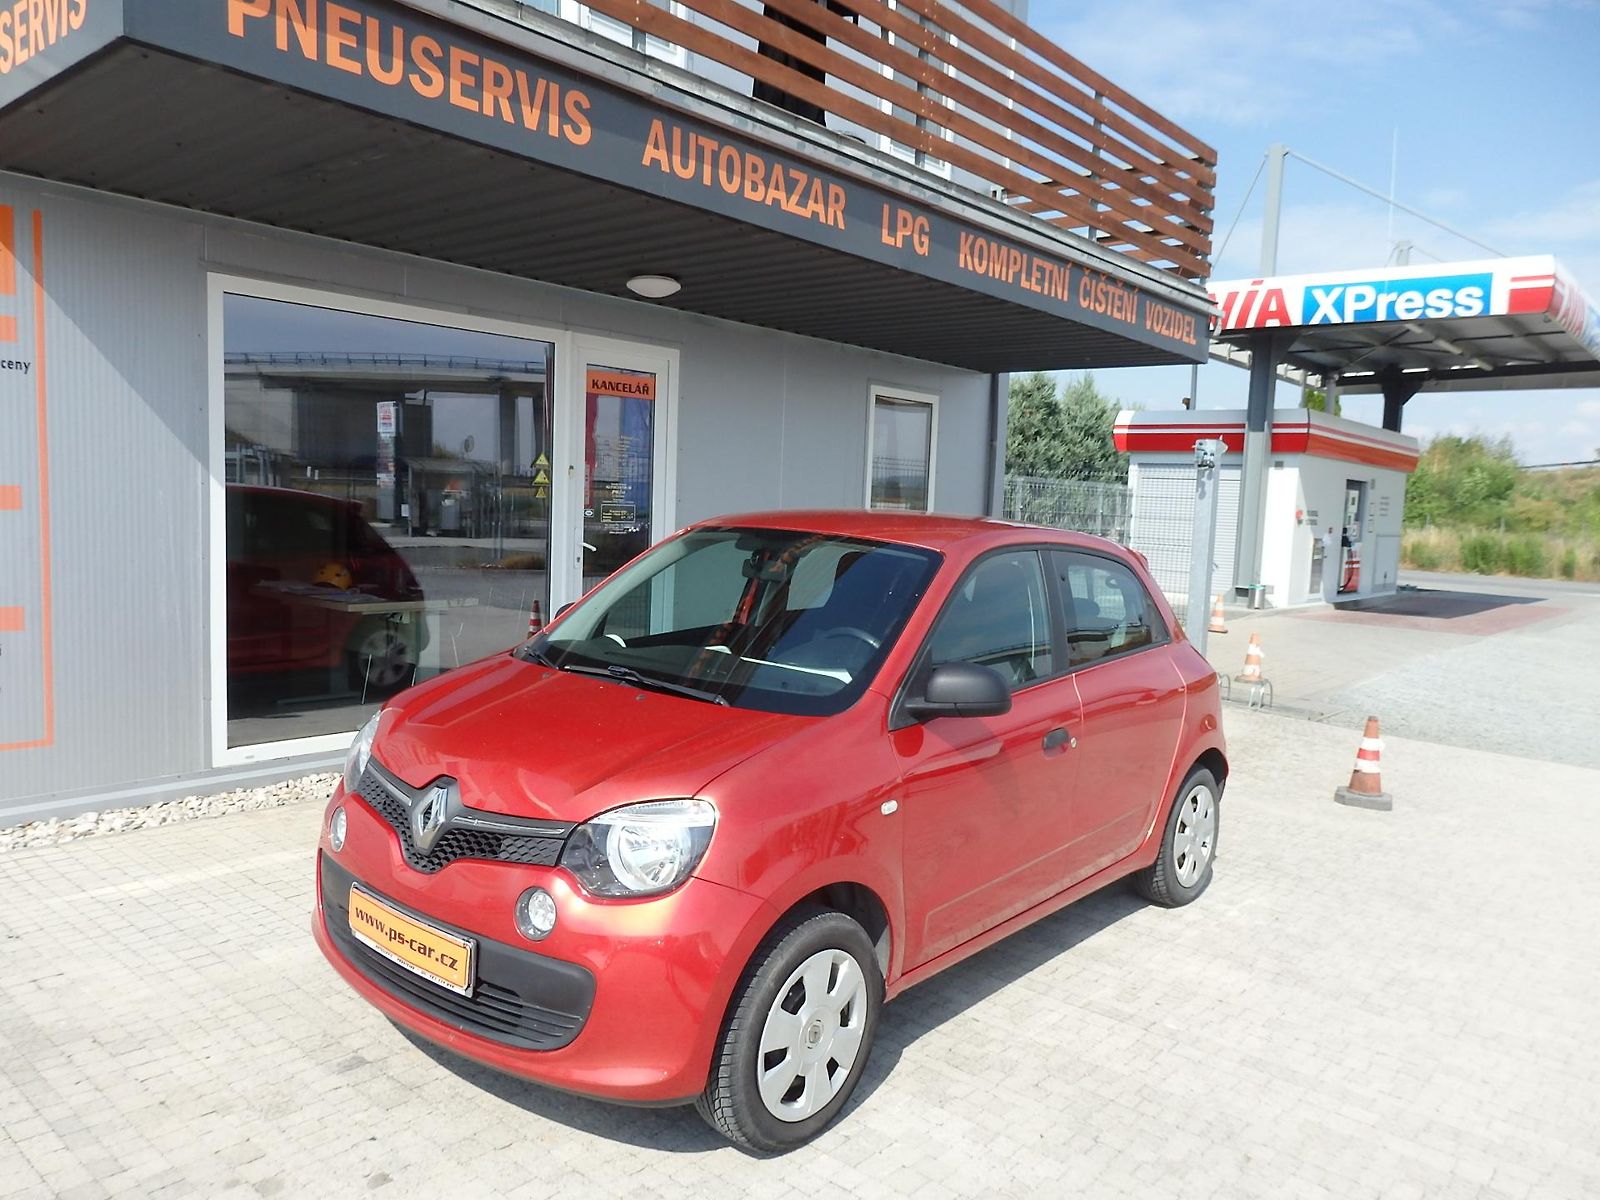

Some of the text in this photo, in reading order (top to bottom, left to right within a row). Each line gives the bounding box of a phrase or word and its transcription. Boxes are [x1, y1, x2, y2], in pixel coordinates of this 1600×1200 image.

[228, 0, 1197, 346] PNEUSERVIS AUTOBAZAR LPG KOMPLETNÍ ČIŠTĚNÍ VOZIDEL
[1309, 284, 1484, 326] XPress
[1, 359, 31, 375] ceny
[591, 379, 650, 396] KANCELÁŘ
[355, 906, 459, 972] www.ps-car.cz
